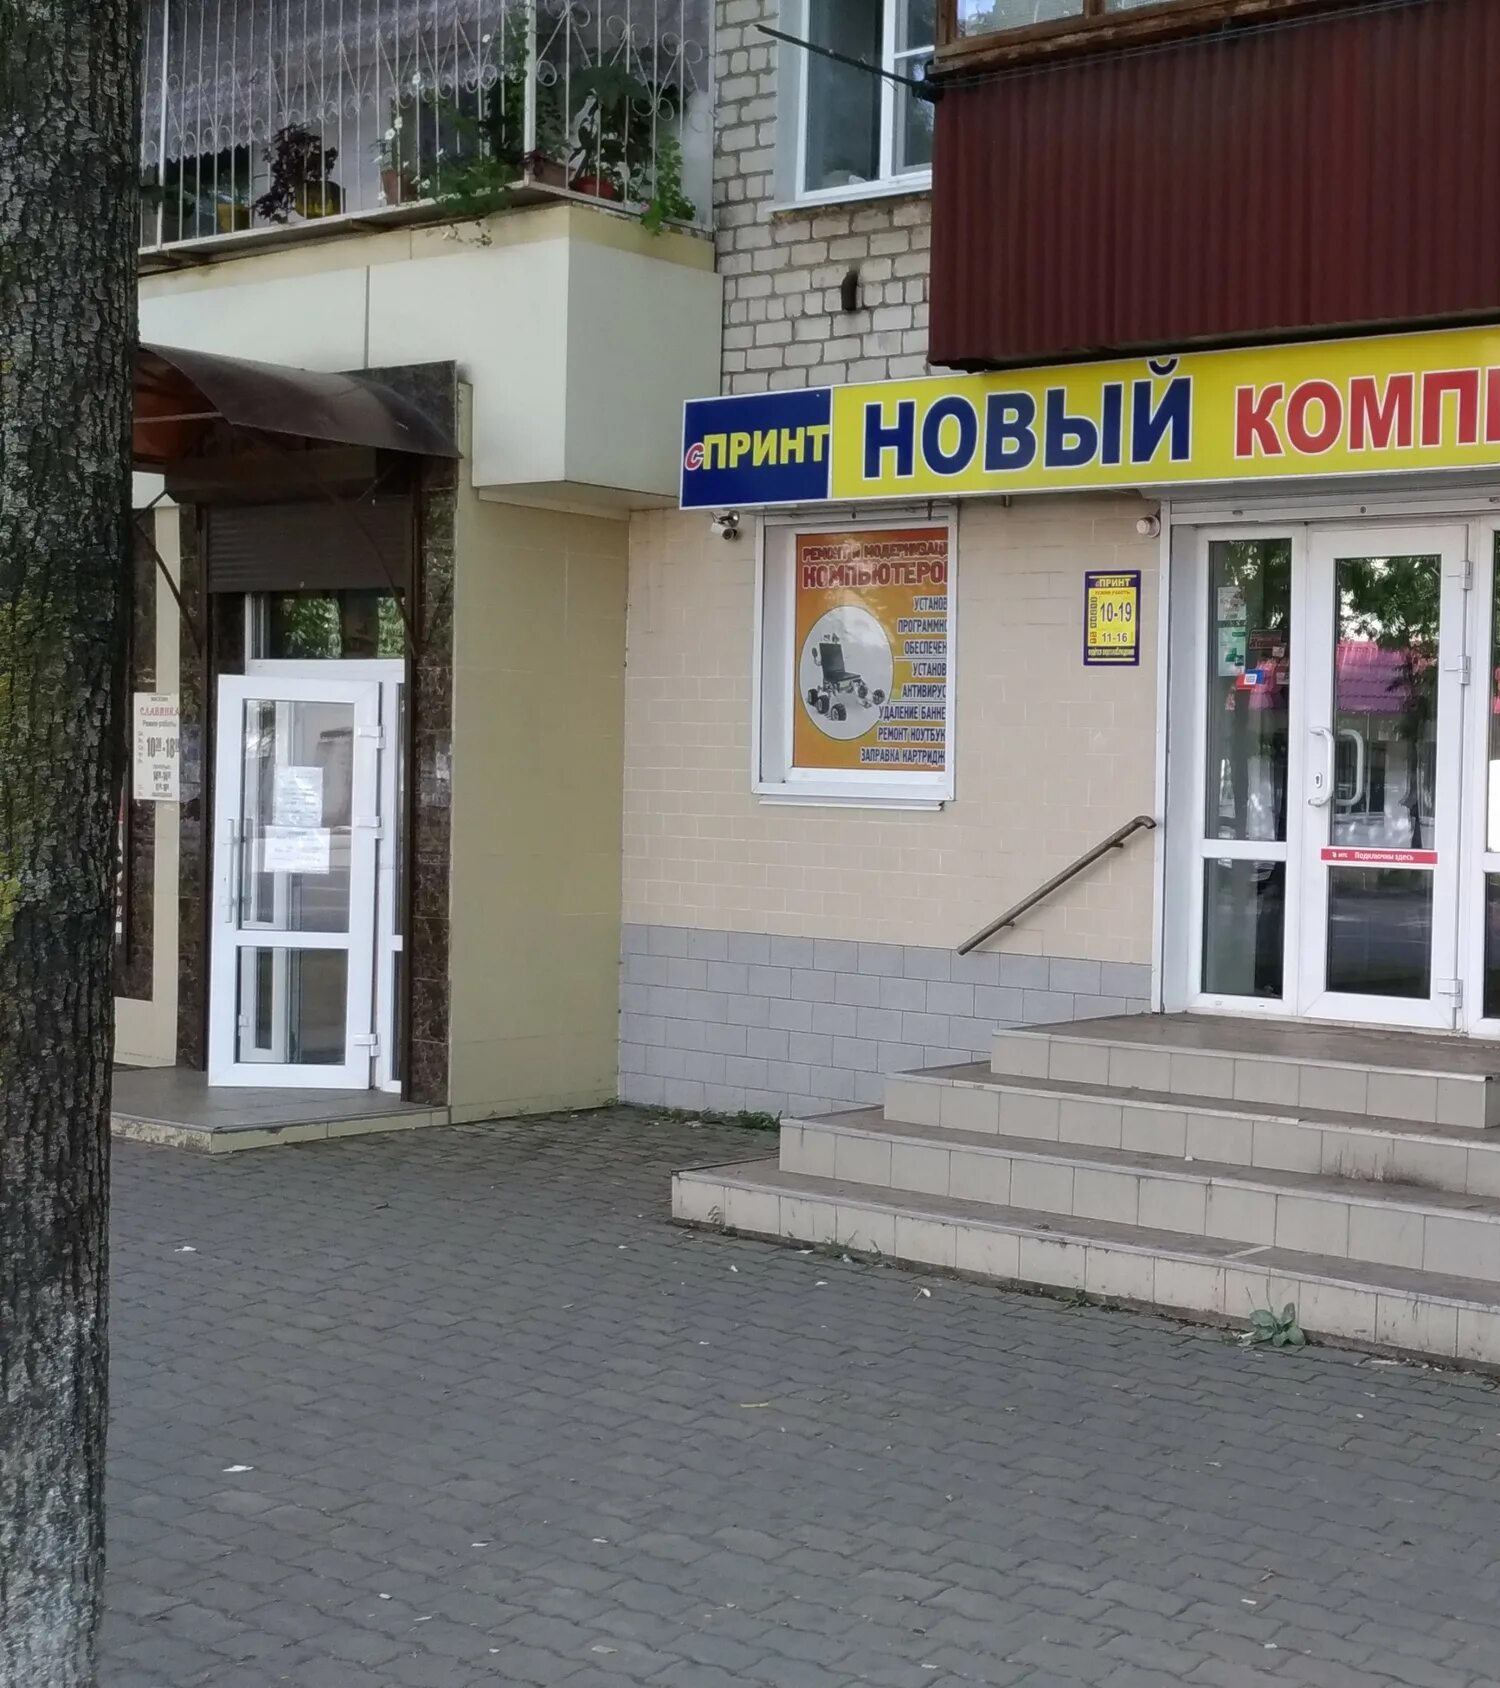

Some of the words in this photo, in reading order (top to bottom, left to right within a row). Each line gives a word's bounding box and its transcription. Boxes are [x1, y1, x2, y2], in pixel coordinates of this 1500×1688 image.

[863, 357, 1194, 481] НОВЫЙ
[1100, 602, 1132, 623] 10-19
[1101, 633, 1128, 643] 11-16
[878, 705, 919, 721] УДАЛЕНИЕ
[878, 727, 908, 741] РЕМОНТ
[860, 748, 900, 762] ЗАПРАВКА
